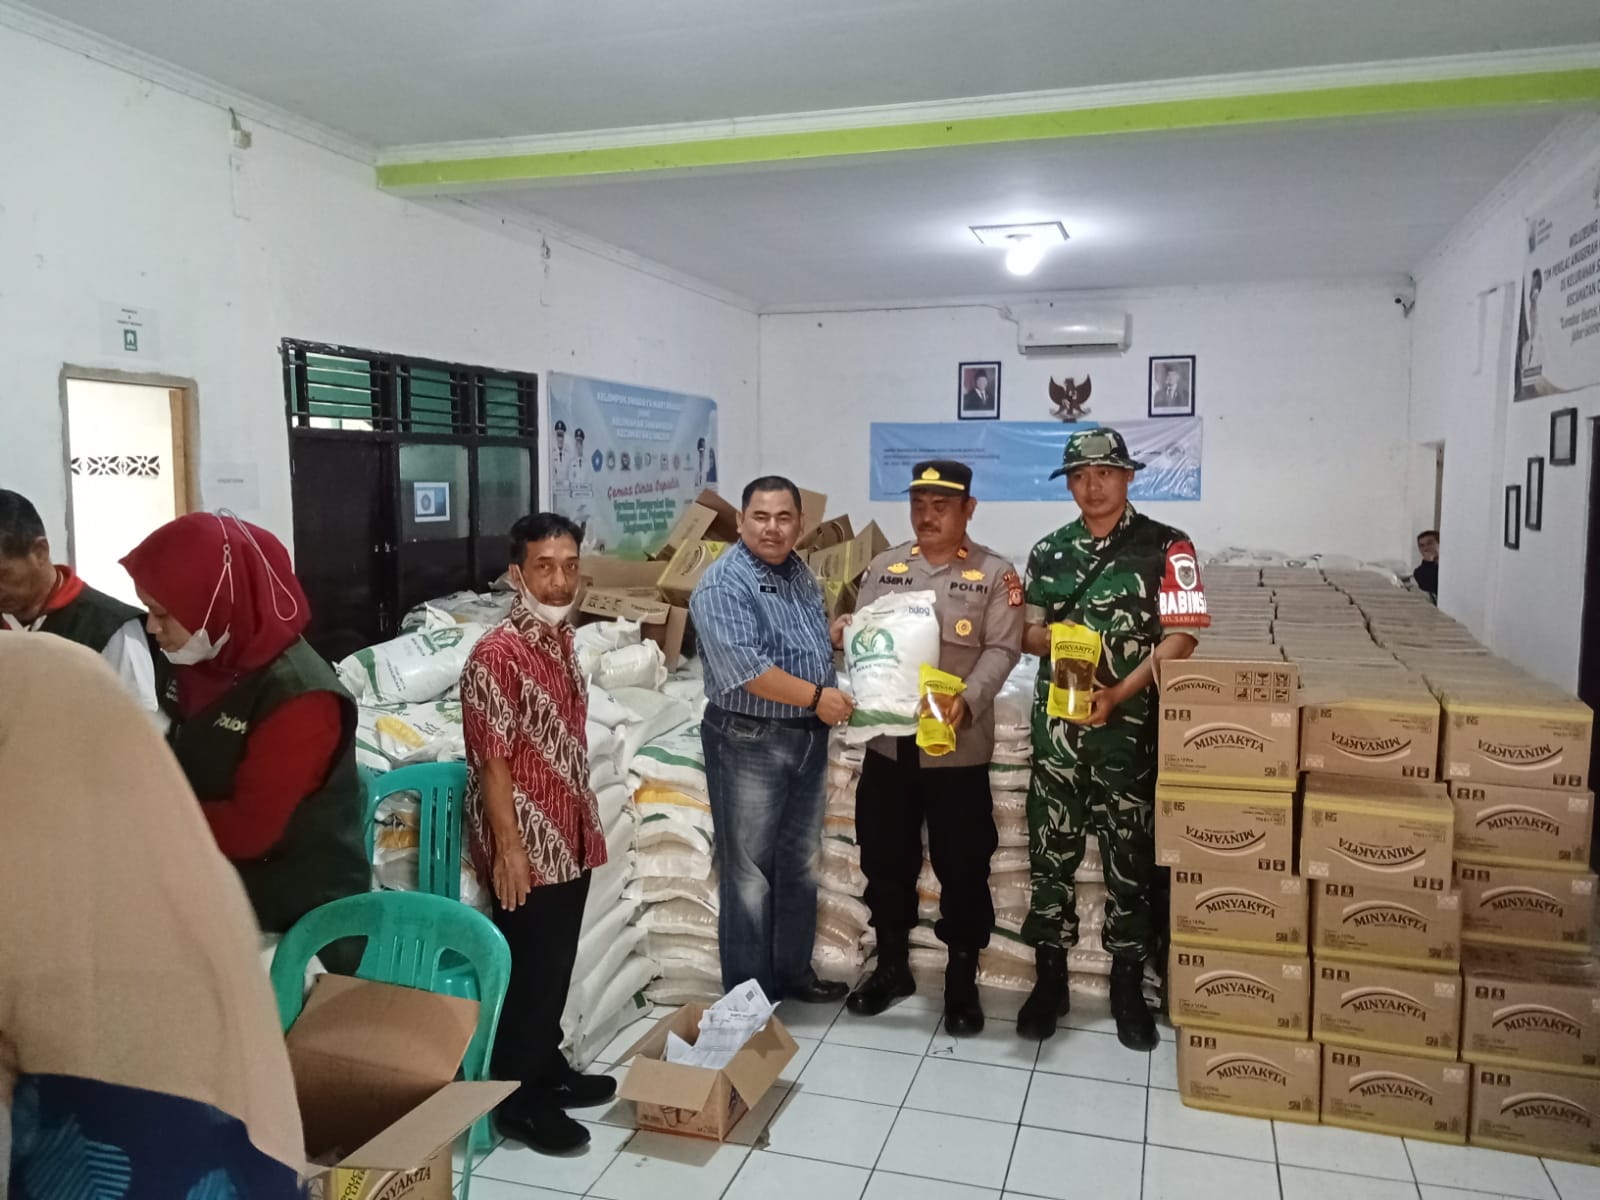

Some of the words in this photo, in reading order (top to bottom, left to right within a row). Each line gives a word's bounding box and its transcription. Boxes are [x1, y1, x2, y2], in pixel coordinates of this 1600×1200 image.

[950, 581, 989, 595] POLRI
[908, 605, 930, 617] bulog
[1159, 590, 1207, 616] BABINS
[1174, 682, 1221, 694] MINYAKITA
[1193, 734, 1264, 753] MINYAKITA
[1331, 731, 1401, 751] MINYAKITA
[1478, 739, 1552, 760] MINYAKITA
[1185, 825, 1255, 845] MINYAKITA
[1486, 815, 1560, 836] MINYAKITA
[1338, 837, 1415, 859] MINYAKITA
[1206, 899, 1275, 919] MINYAKITA
[1491, 898, 1564, 918] MINYAKITA
[1353, 912, 1428, 933] MINYAKITA
[1205, 982, 1275, 1004] MINYAKITA
[1352, 999, 1426, 1022] MINYAKITA
[1503, 1016, 1582, 1040] MINYAKITA
[1217, 1065, 1287, 1087] MINYAKITA
[1360, 1083, 1434, 1106] MINYAKITA
[380, 1166, 431, 1200] NYAKITA
